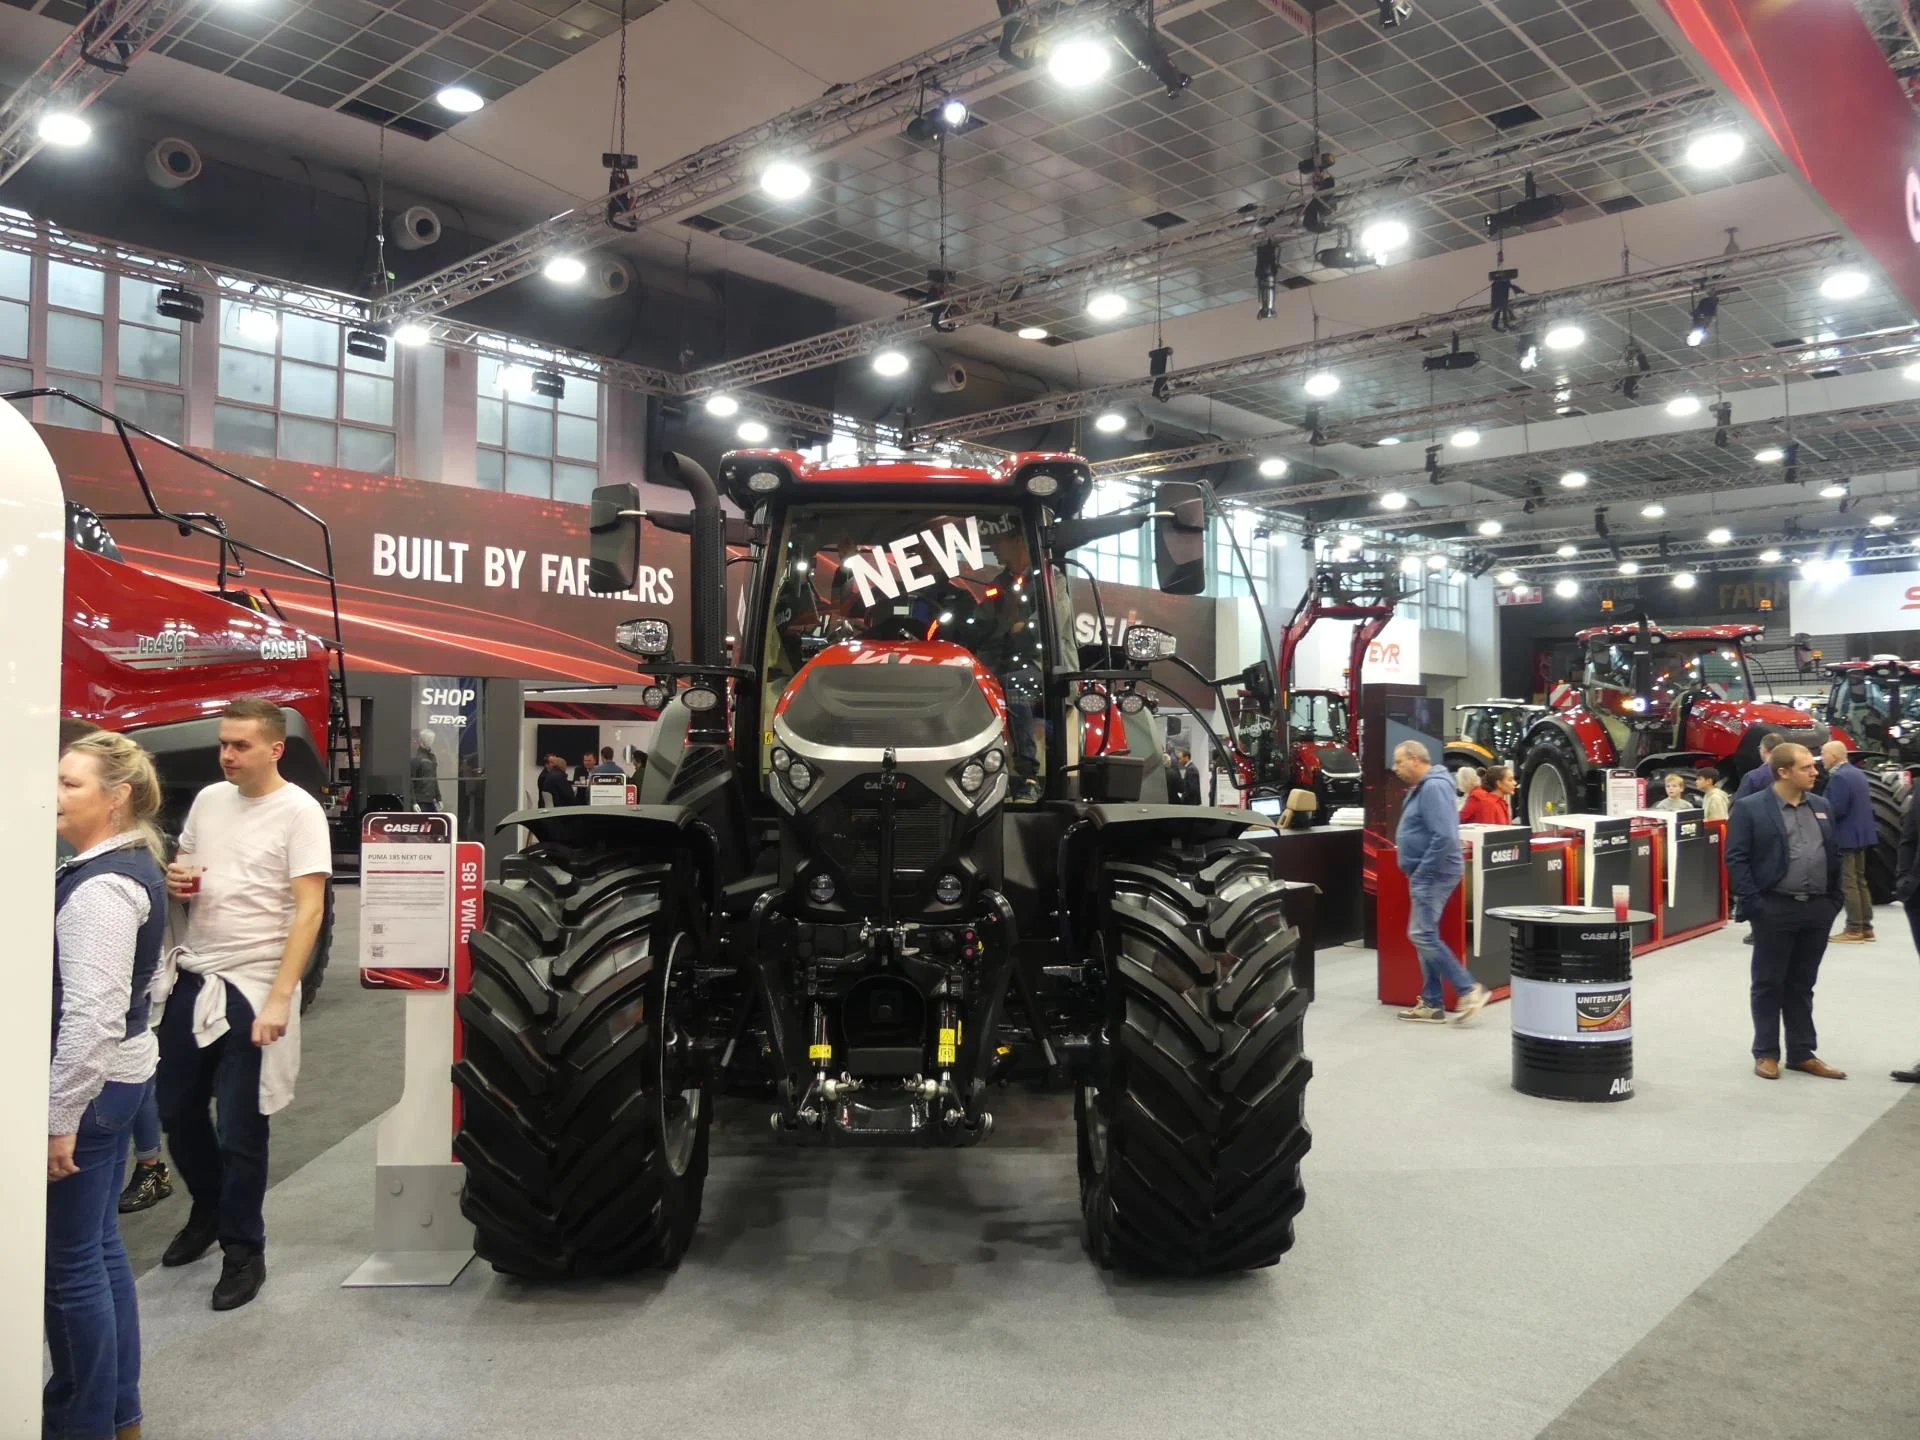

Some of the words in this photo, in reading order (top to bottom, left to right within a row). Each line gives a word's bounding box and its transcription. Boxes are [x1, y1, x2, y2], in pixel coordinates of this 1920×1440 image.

[373, 533, 469, 583] BUILT
[484, 546, 526, 589] BY
[541, 553, 675, 605] FARRS
[850, 516, 984, 608] NEW
[261, 640, 296, 660] CASE
[1366, 641, 1400, 664] EYR
[421, 688, 475, 706] SHOP
[428, 715, 467, 725] STEYR
[384, 823, 419, 833] CASE
[1491, 849, 1512, 863] CASE
[1637, 845, 1650, 856] INFO
[1547, 859, 1562, 871] INFO
[461, 862, 477, 891] 185
[1580, 932, 1609, 940] CASE
[1577, 996, 1606, 1004] UNITEK
[1607, 994, 1622, 1002] PLUS
